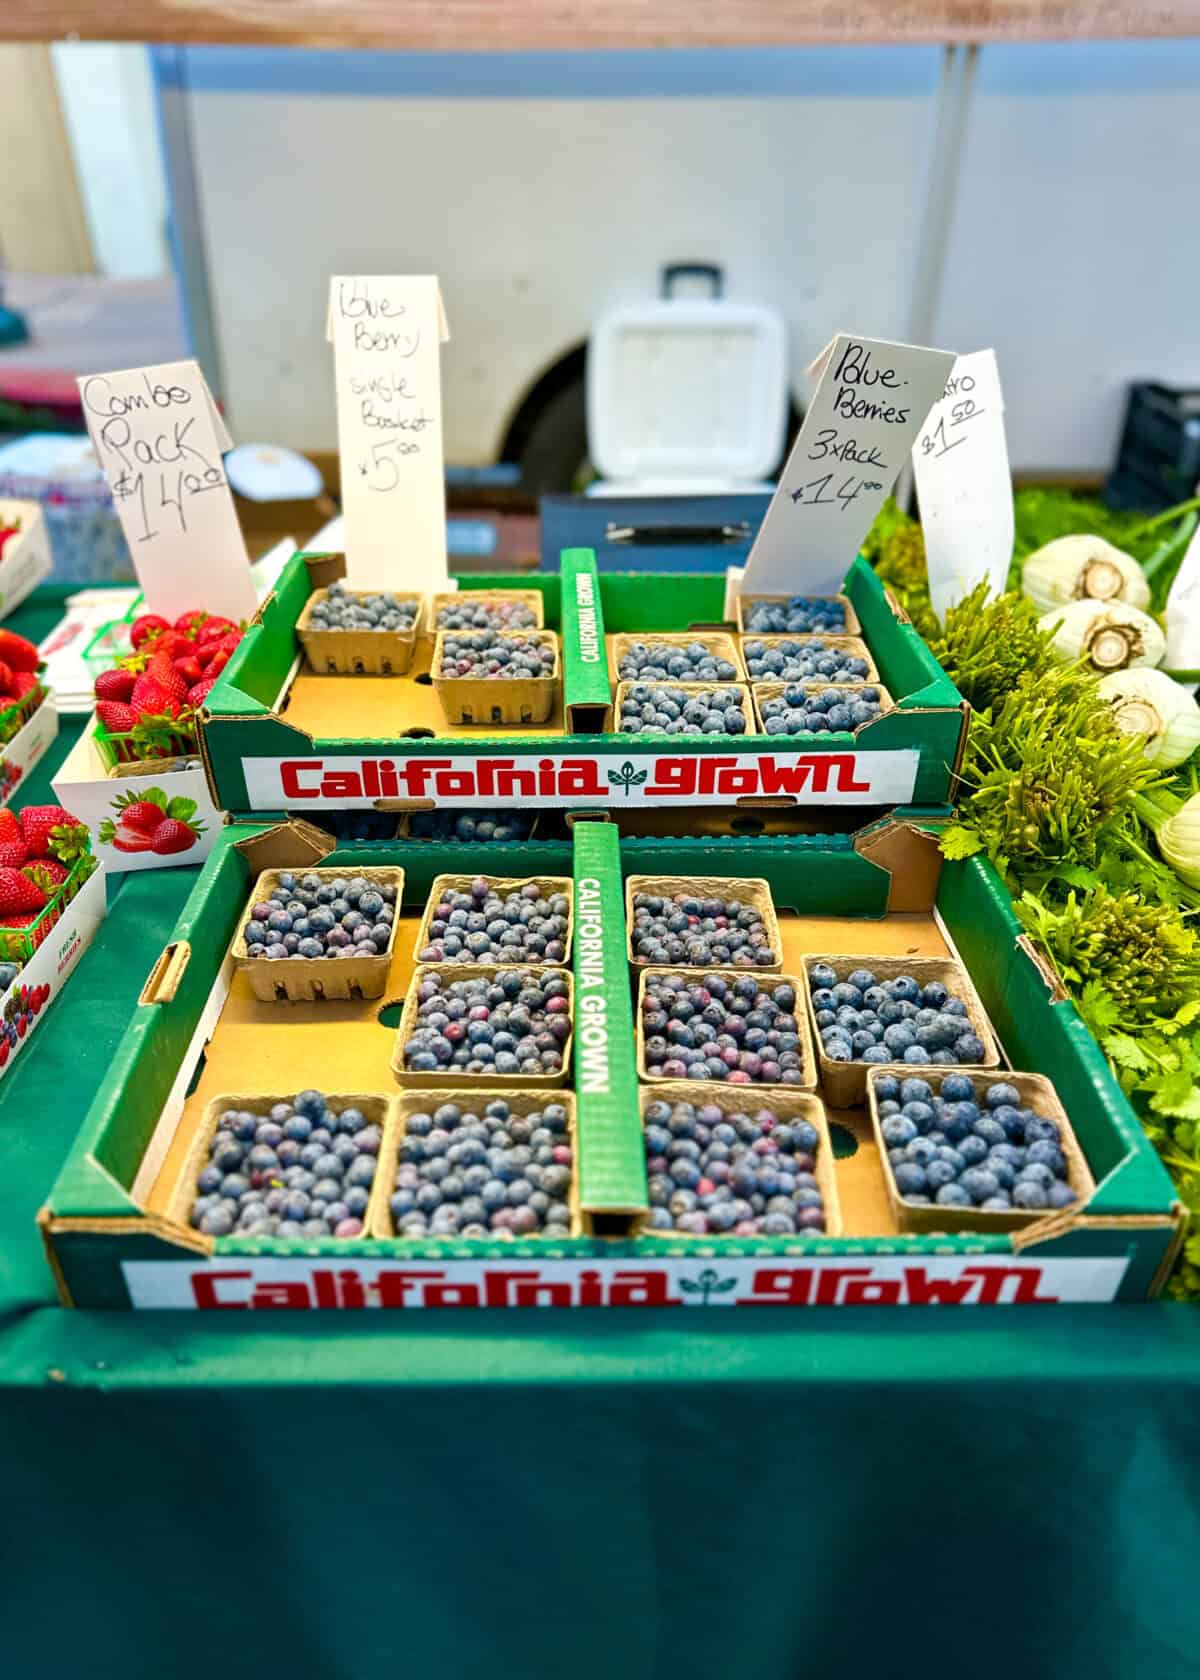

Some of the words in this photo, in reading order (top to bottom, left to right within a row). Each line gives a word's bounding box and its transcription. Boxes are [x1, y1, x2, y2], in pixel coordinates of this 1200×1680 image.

[84, 373, 191, 417] Combo
[833, 386, 911, 424] Berries
[102, 417, 213, 471] Pack
[578, 607, 601, 663] CALIFORNIA
[280, 759, 609, 798] California
[643, 754, 871, 796] grown
[578, 878, 604, 990] CALIFORNIA
[579, 993, 611, 1094] GROWN
[190, 1269, 684, 1308] California
